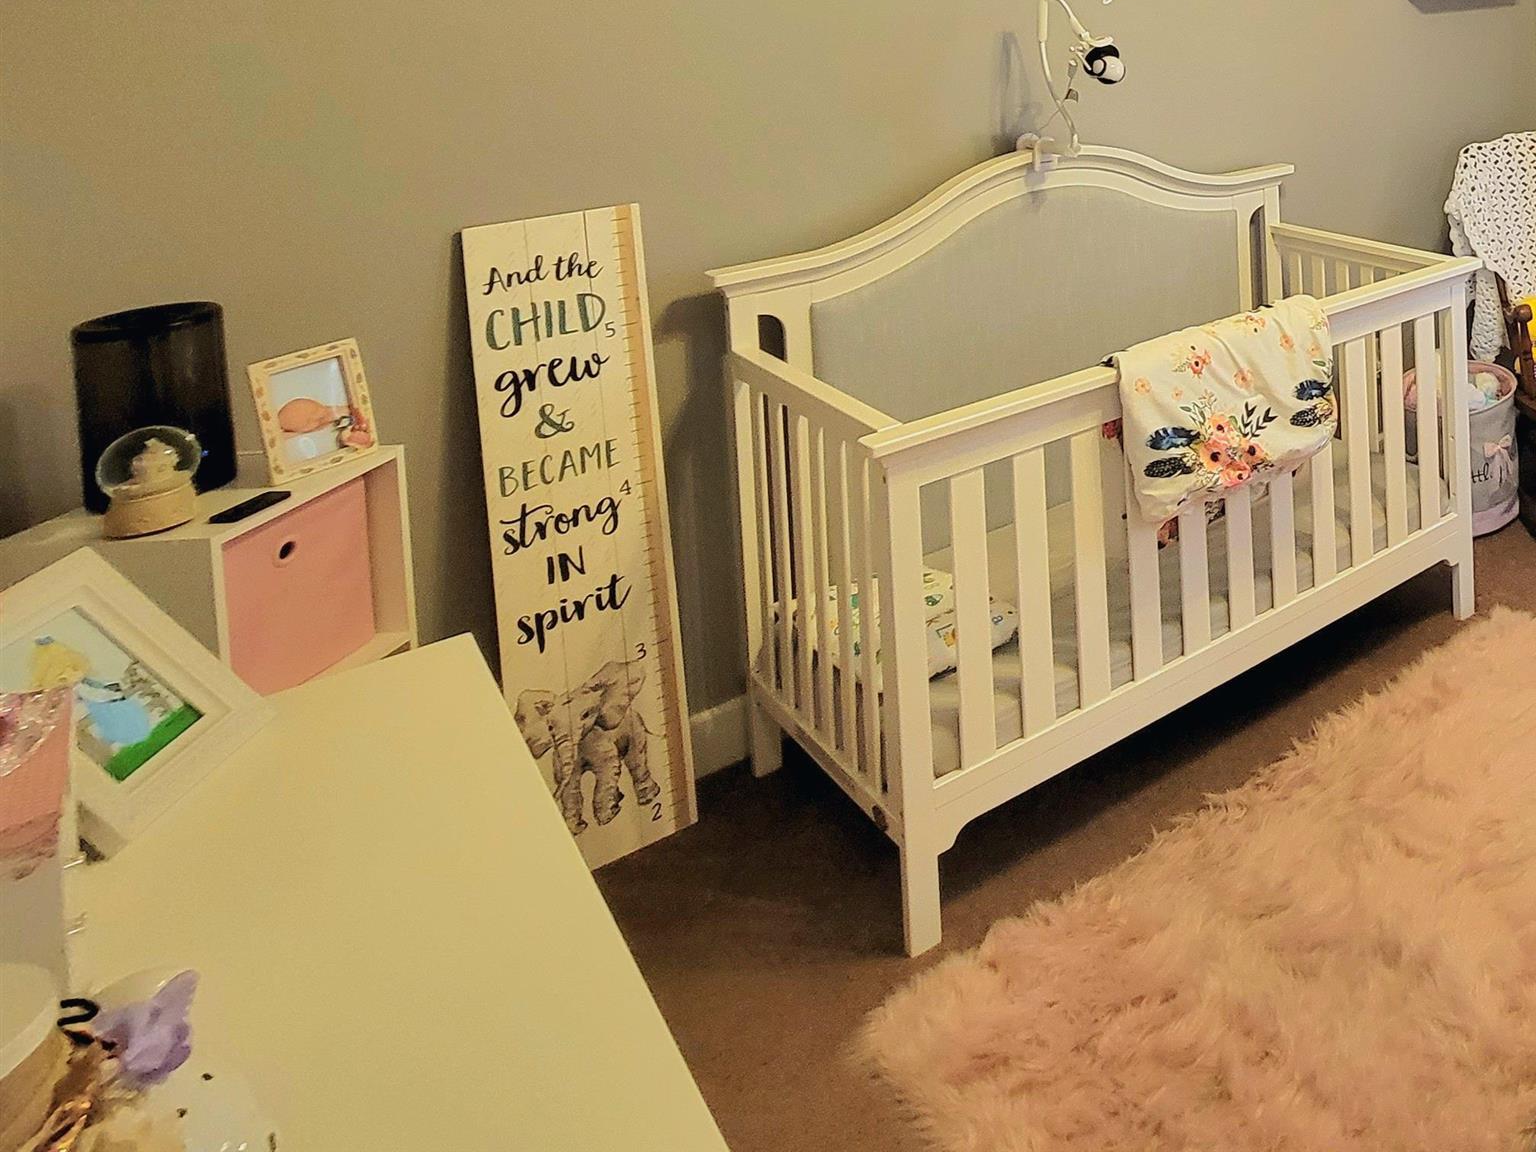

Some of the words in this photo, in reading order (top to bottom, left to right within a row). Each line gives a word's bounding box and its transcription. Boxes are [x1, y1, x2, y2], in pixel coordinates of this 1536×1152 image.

[482, 255, 548, 295] And
[553, 252, 603, 281] the
[486, 293, 606, 351] CHILD
[604, 322, 616, 337] 5
[495, 352, 611, 417] grew
[534, 403, 575, 438] &
[498, 438, 621, 497] BECAME
[619, 480, 632, 495] 4
[500, 495, 622, 555] strong
[546, 545, 586, 584] IN
[516, 574, 632, 653] spirit
[635, 643, 647, 659] 3
[651, 804, 663, 822] 2
